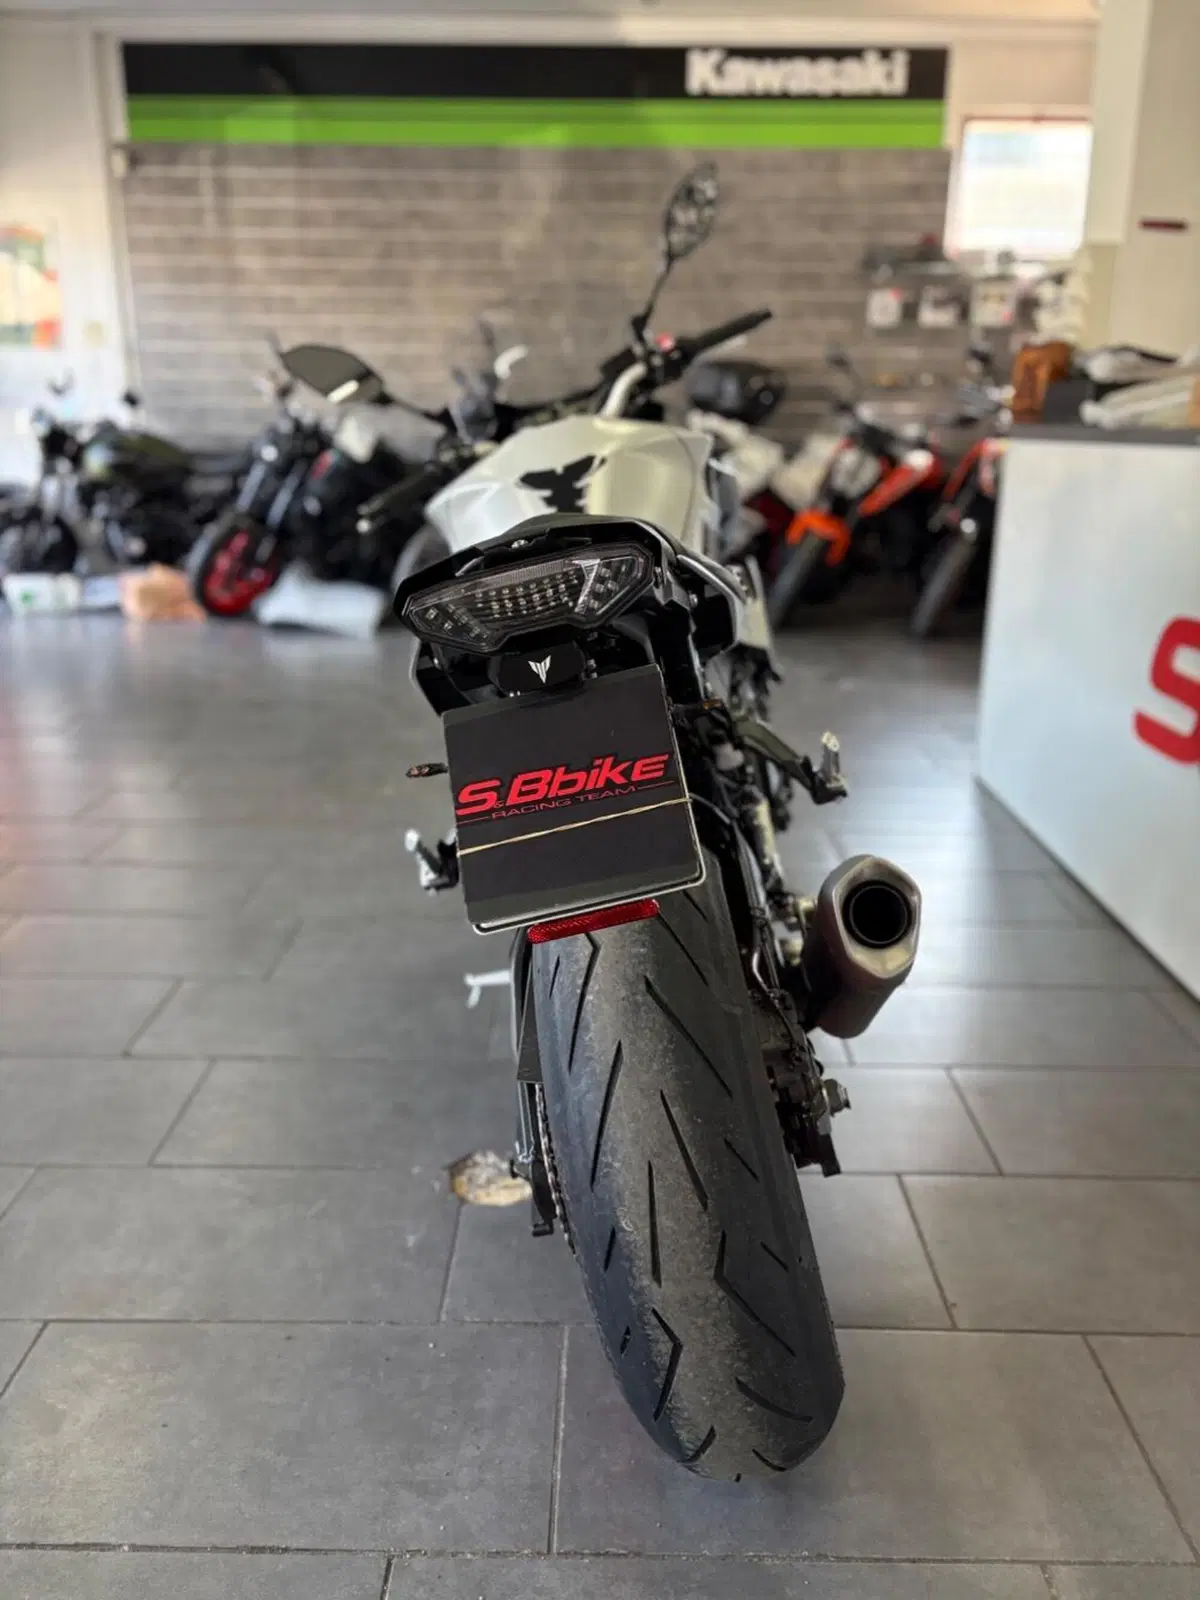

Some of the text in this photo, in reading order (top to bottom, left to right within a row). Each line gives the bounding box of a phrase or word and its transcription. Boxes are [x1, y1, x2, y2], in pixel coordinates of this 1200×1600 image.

[685, 48, 909, 96] Kawasaki
[491, 786, 636, 819] RACING TEAM
